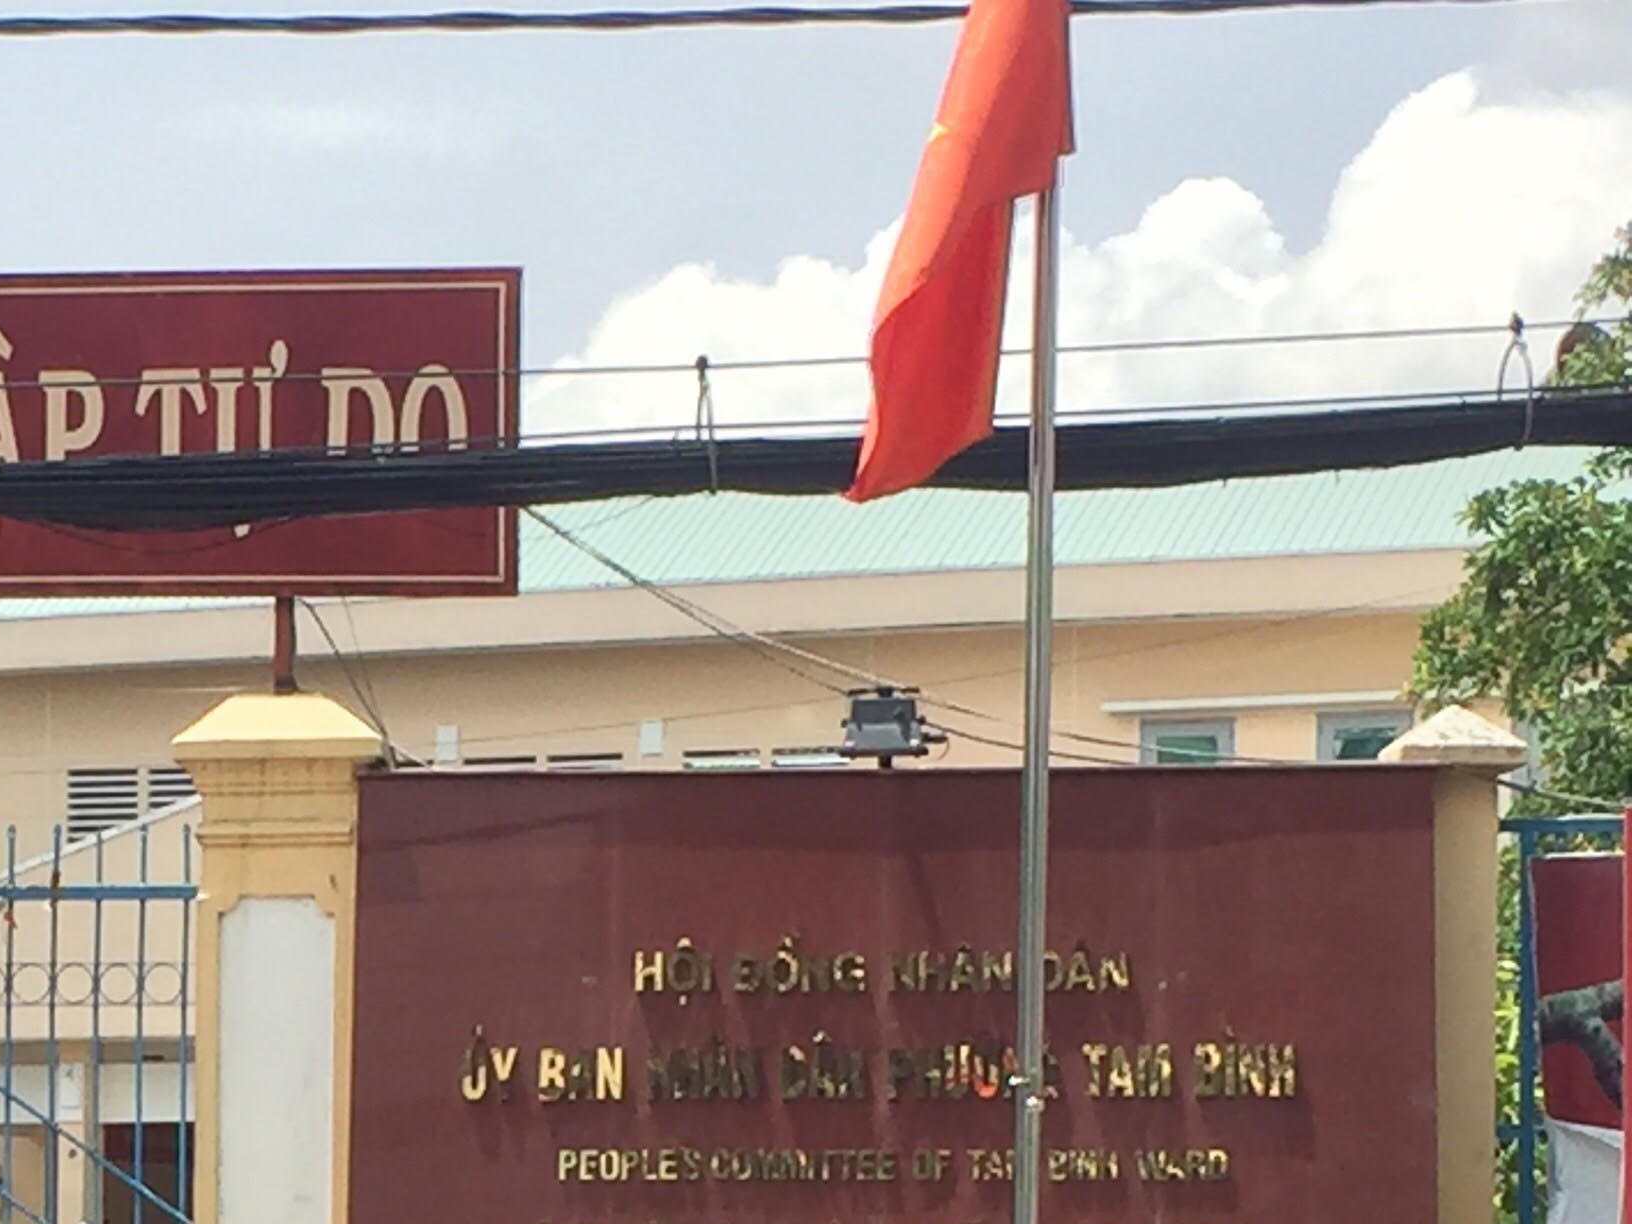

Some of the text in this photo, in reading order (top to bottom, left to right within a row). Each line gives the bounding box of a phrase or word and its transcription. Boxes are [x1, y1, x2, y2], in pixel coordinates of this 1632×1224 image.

[321, 364, 469, 457] DO
[537, 1046, 625, 1101] BAN
[912, 1149, 952, 1182] OF
[1137, 1149, 1228, 1181] WARD
